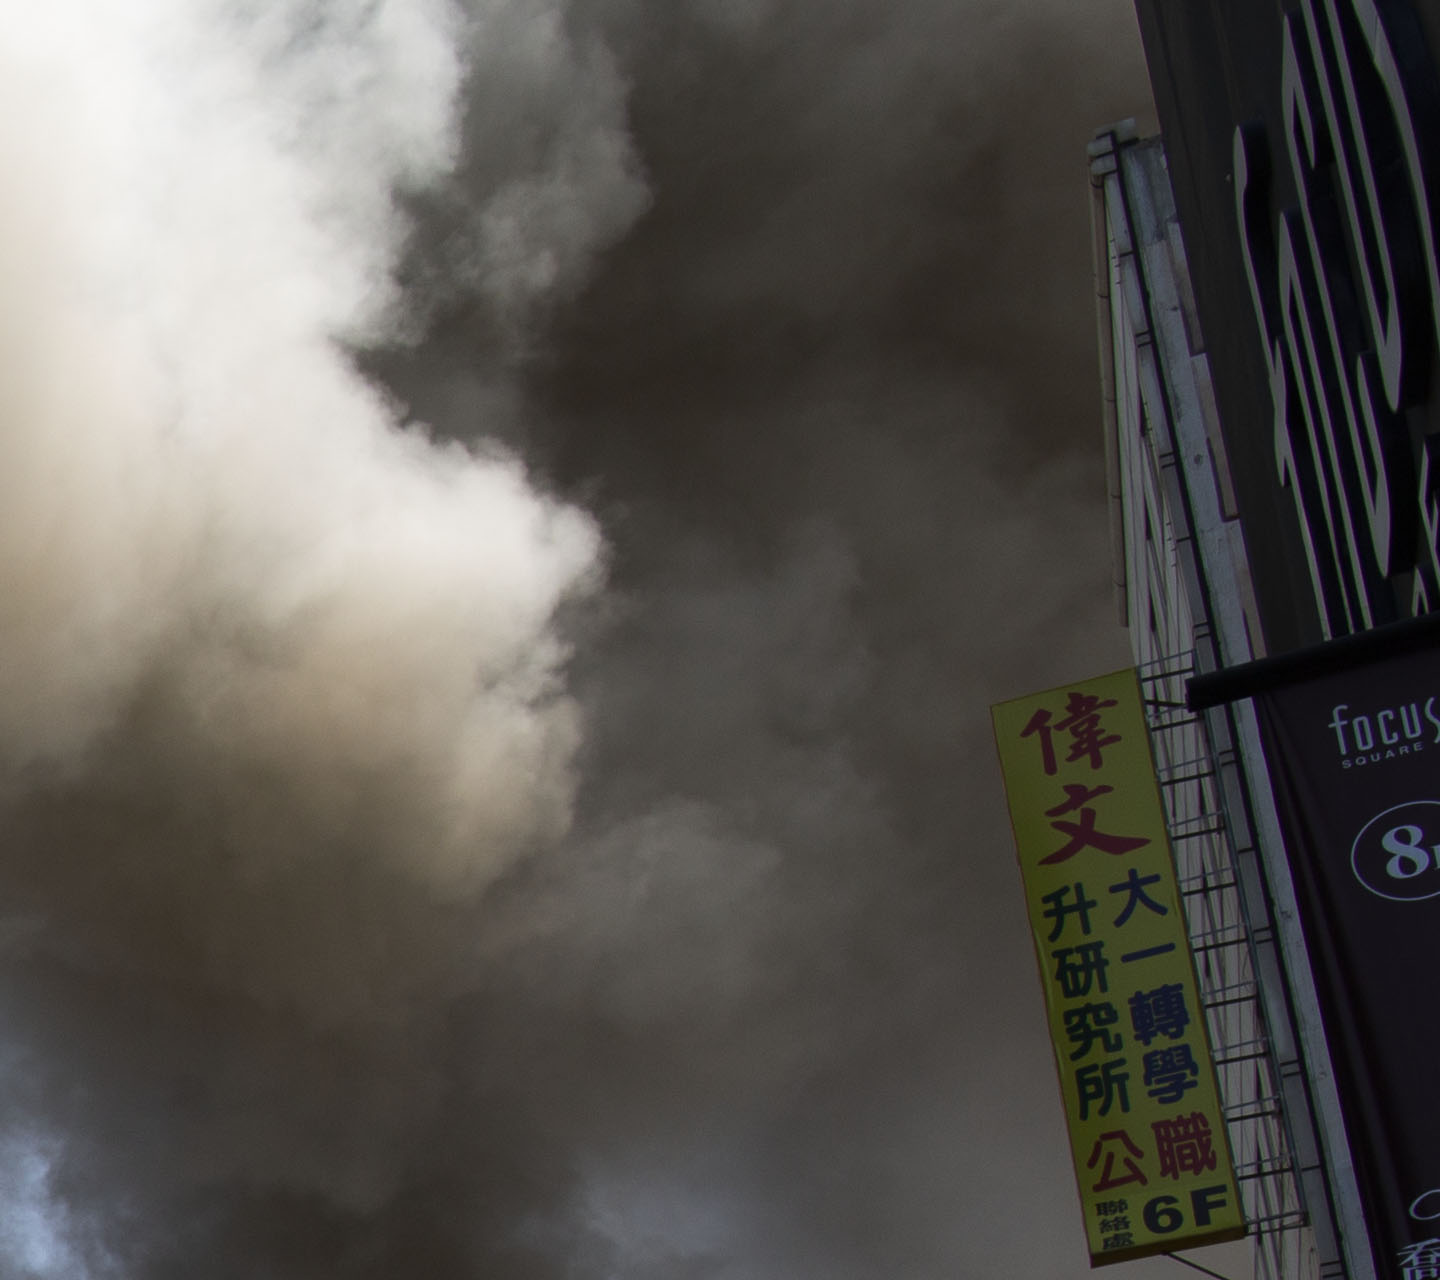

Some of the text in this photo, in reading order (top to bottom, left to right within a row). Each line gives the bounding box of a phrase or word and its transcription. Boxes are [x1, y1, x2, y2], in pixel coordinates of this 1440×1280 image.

[1020, 692, 1152, 867] 偉文
[1342, 741, 1426, 769] SQUARE
[1041, 882, 1130, 1121] 升研究所
[1109, 868, 1198, 1104] 大一轉學
[1088, 1112, 1217, 1193] 公職
[1143, 1184, 1228, 1235] 6F
